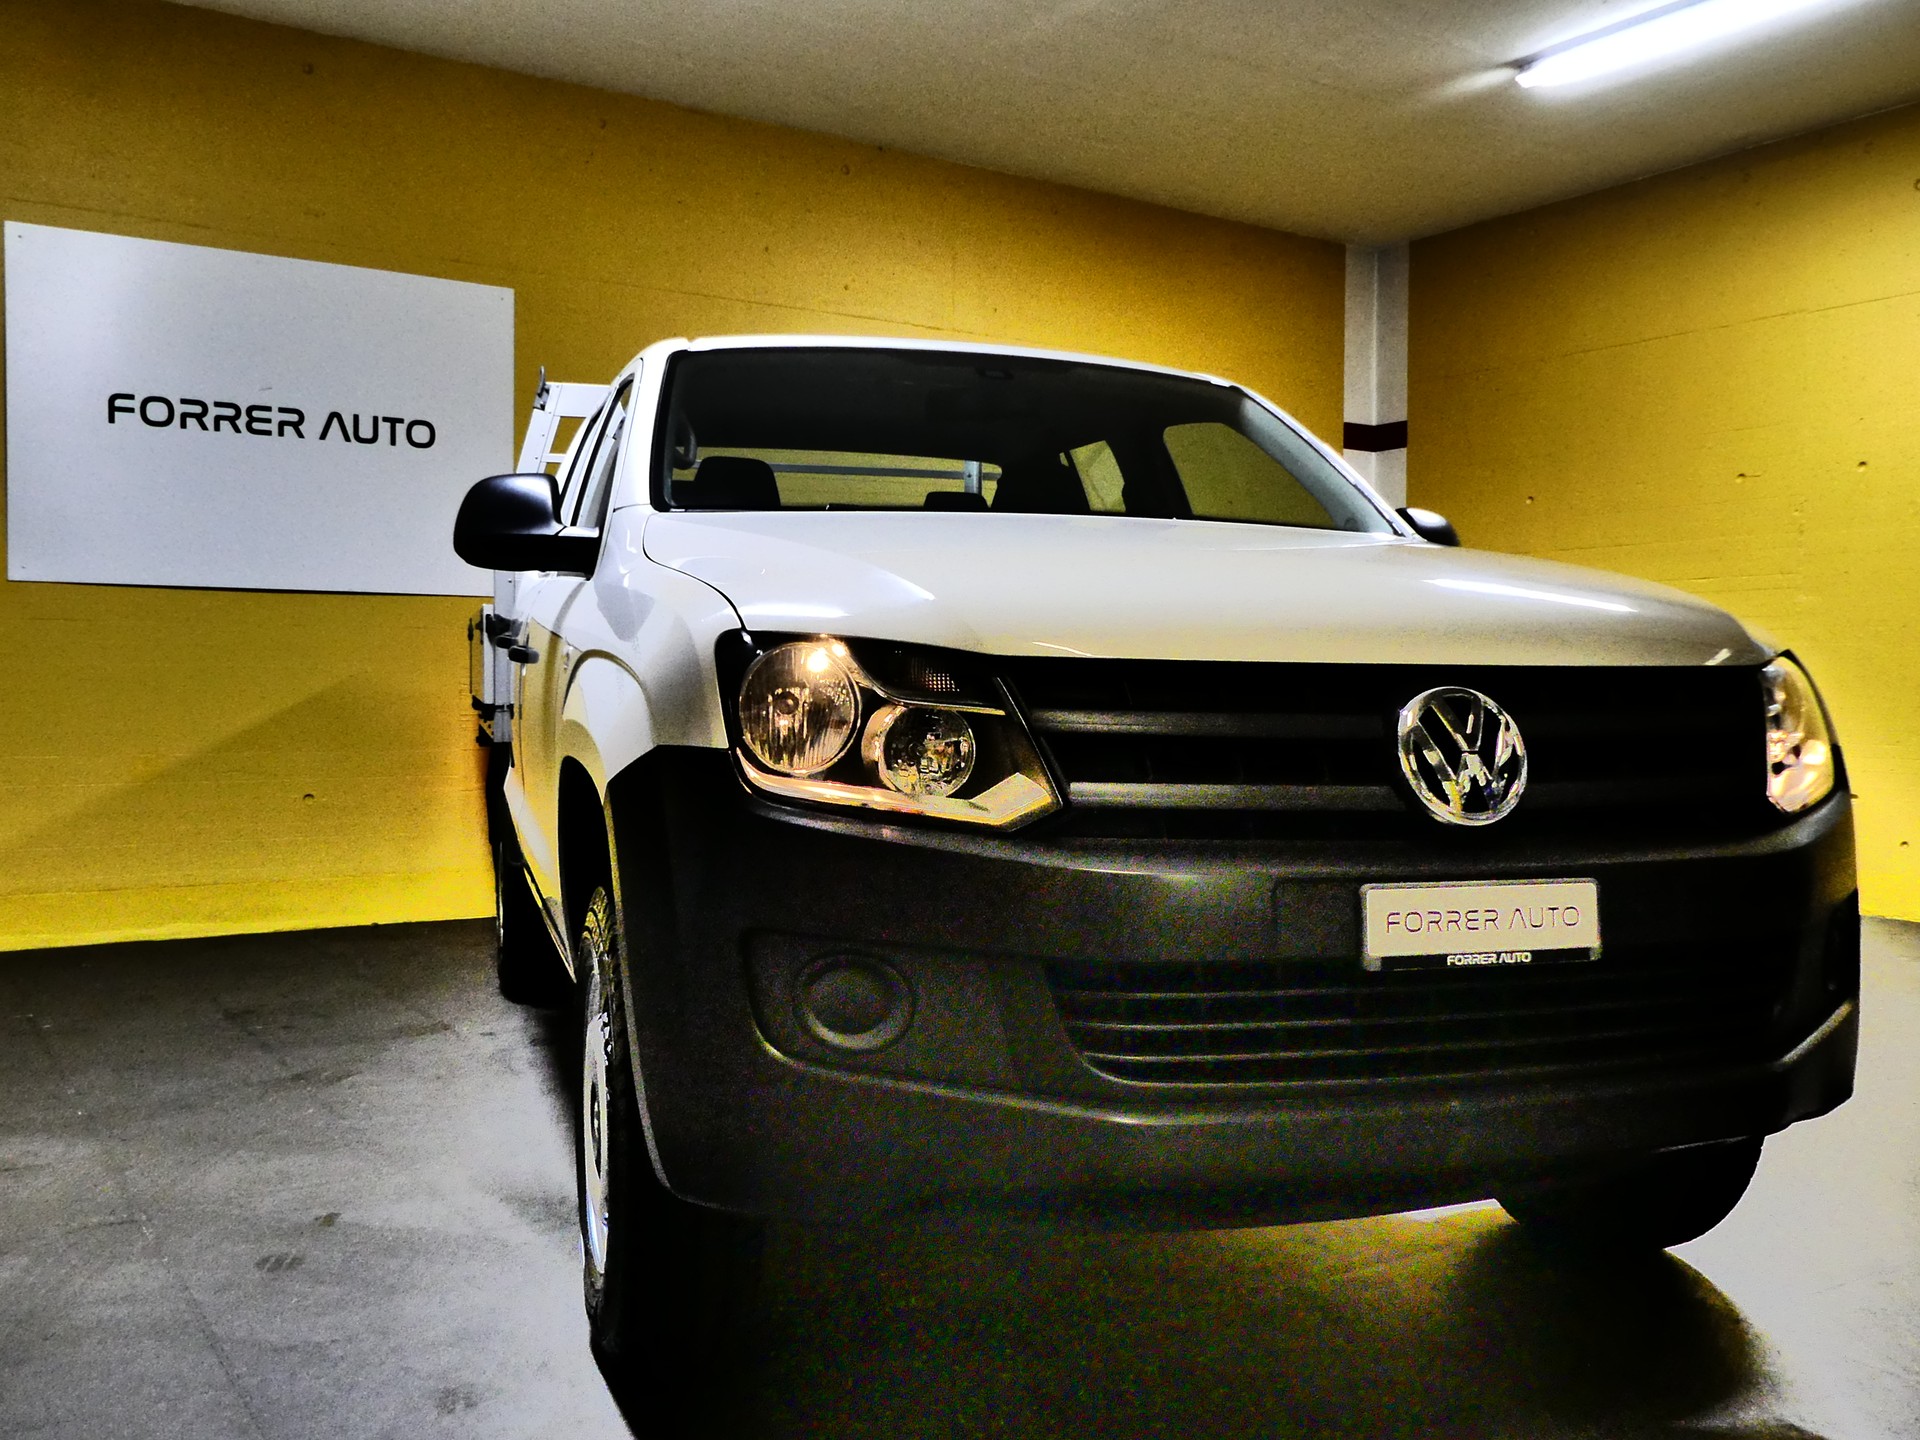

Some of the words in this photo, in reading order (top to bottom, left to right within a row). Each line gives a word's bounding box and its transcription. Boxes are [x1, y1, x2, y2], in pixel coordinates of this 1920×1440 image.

[108, 393, 305, 439] FORRER
[319, 411, 436, 449] AUTO
[1386, 909, 1499, 933] FORRER
[1508, 906, 1580, 929] AUTO
[1447, 953, 1498, 966] FORRER
[1499, 952, 1532, 963] AUTO
